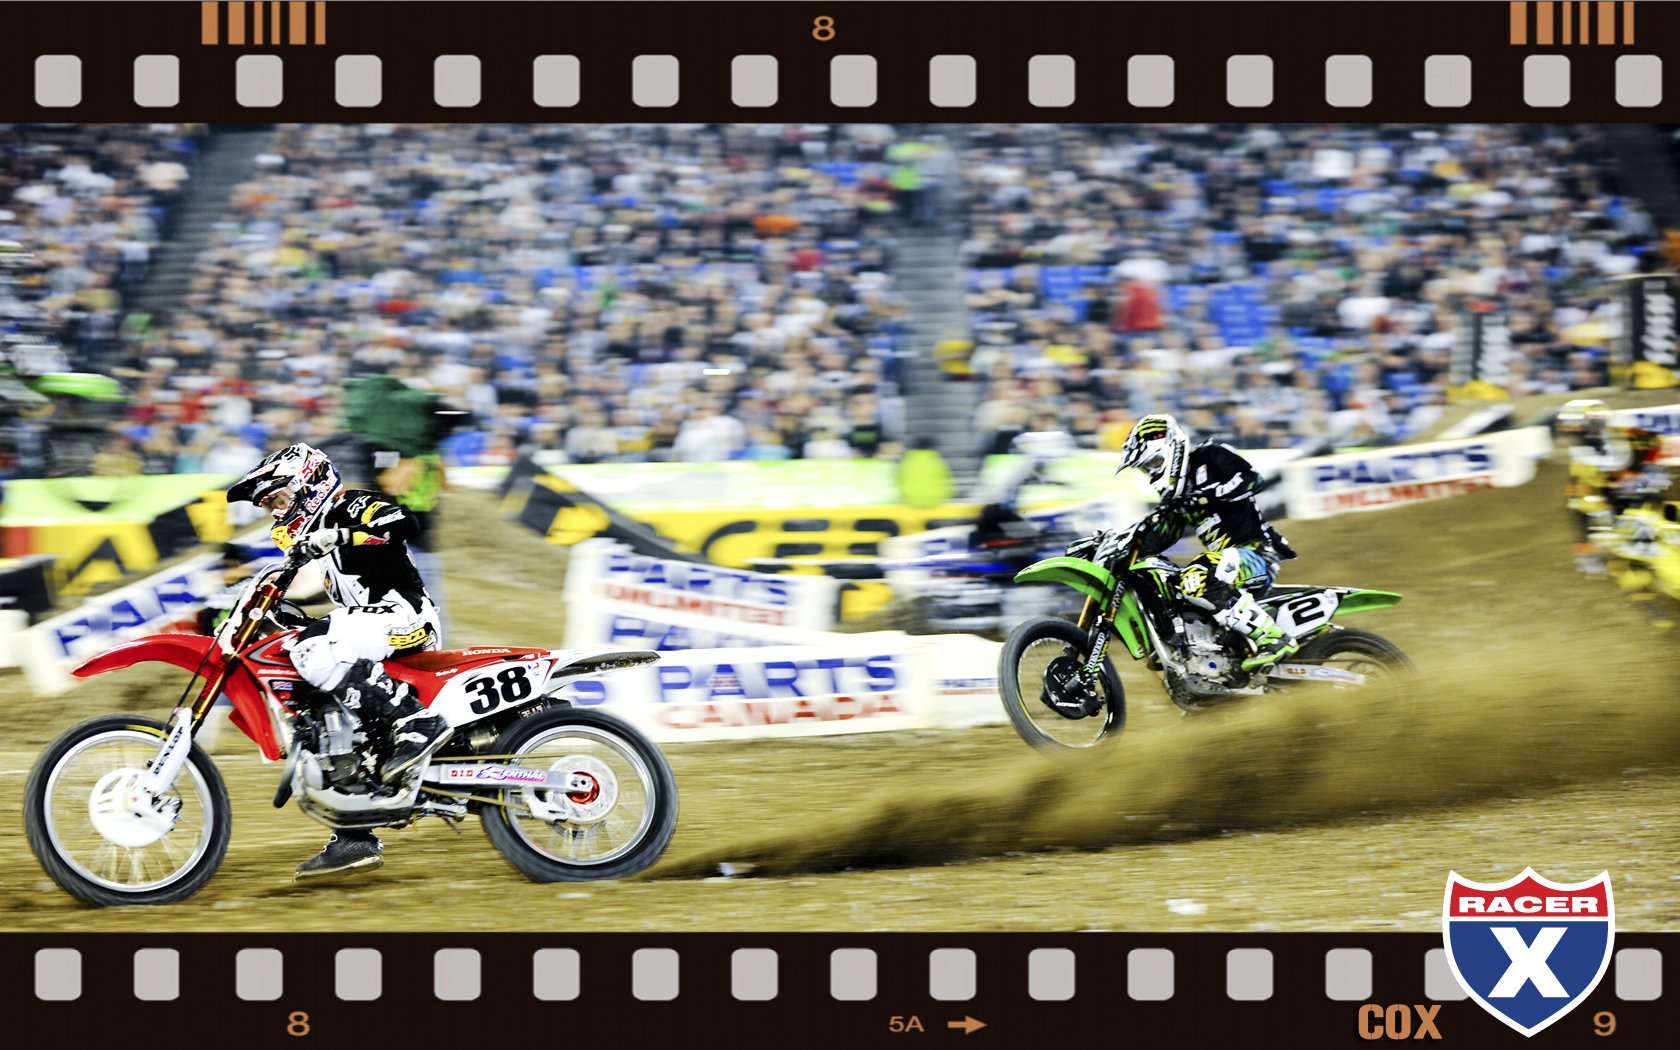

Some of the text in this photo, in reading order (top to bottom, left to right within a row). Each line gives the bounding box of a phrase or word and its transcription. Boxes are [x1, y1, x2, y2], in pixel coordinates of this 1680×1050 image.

[1313, 444, 1491, 492] PARTS
[607, 554, 787, 607] PARTS
[347, 603, 400, 614] FOX
[1287, 597, 1325, 626] 2
[461, 648, 512, 656] HONDA
[1087, 632, 1106, 671] DUNLOP
[464, 666, 532, 715] 38
[658, 655, 898, 701] PARTS
[660, 695, 903, 730] CANADA
